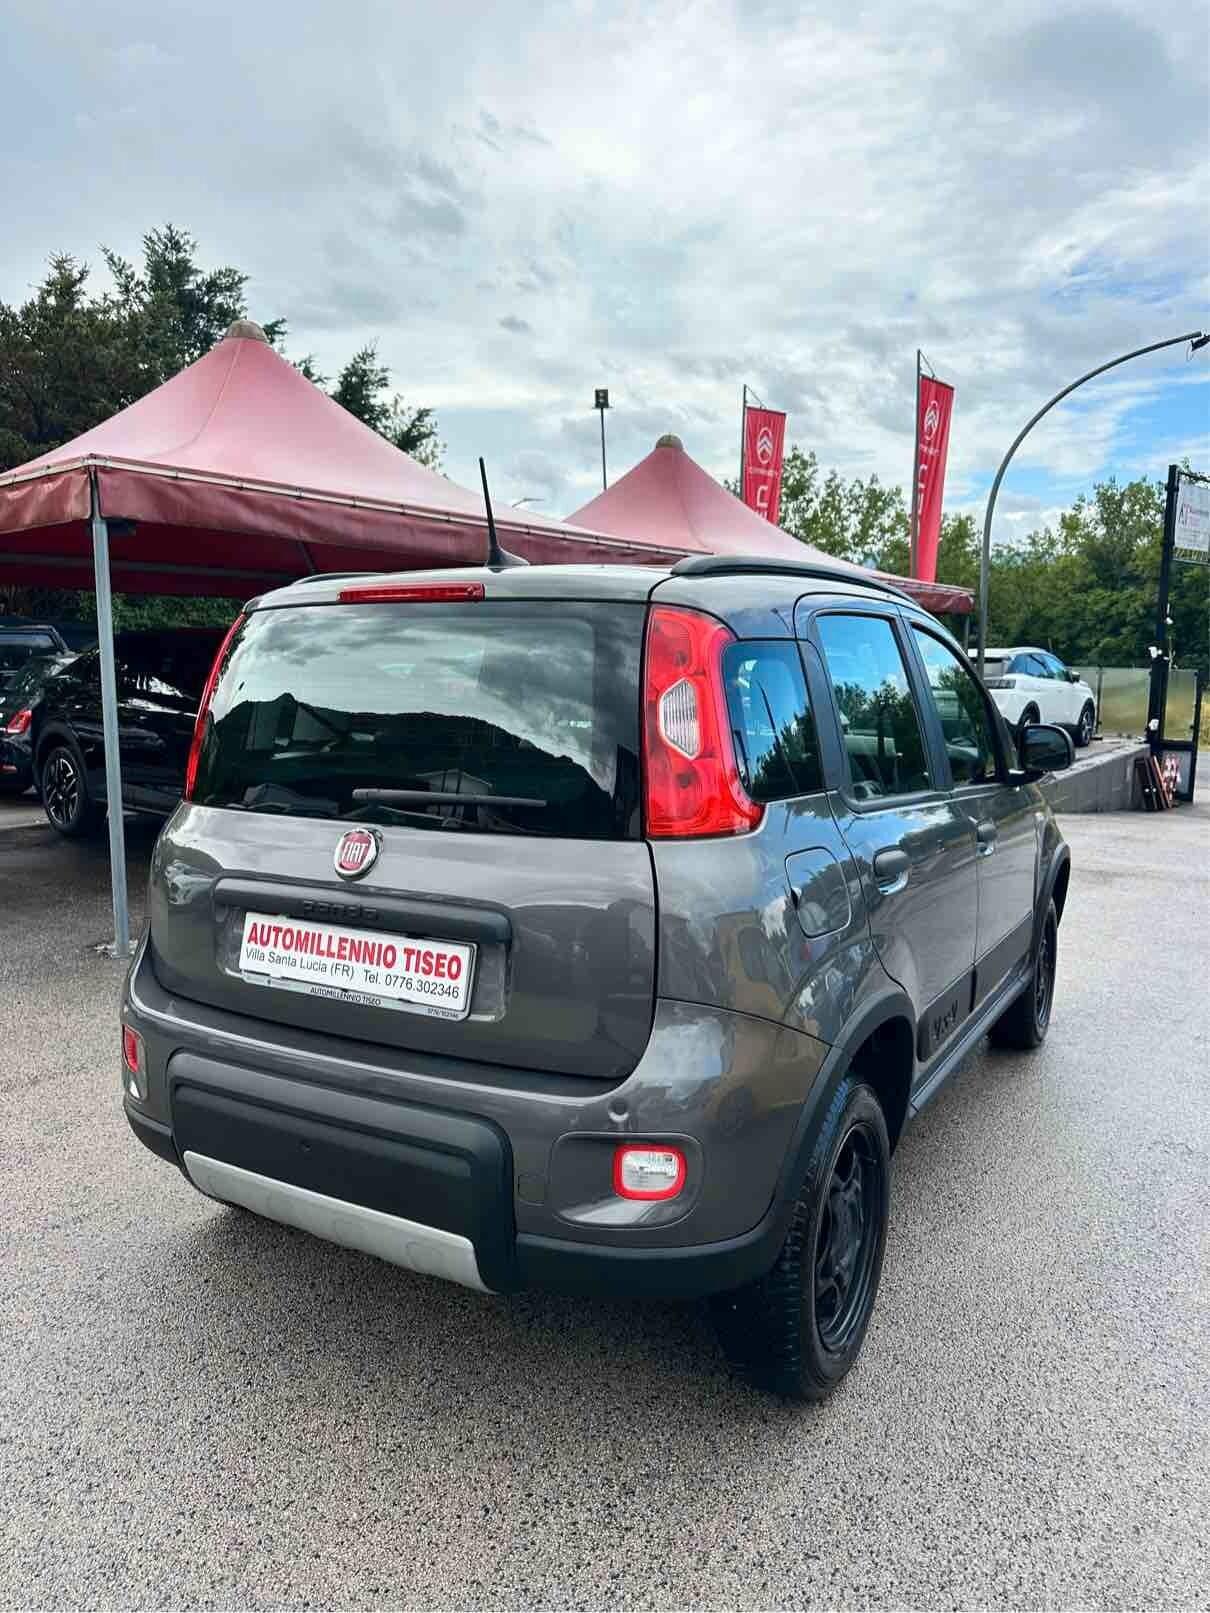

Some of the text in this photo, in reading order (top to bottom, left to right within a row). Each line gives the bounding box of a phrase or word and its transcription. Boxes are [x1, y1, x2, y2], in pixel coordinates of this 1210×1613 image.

[341, 840, 369, 864] FIAT
[247, 922, 462, 981] AUTOMILLENNIO TISEO
[246, 947, 460, 999] Villa Santa Lucia (FR) Tel. 0776.302346
[310, 986, 362, 1001] AUTOMILLENNIO
